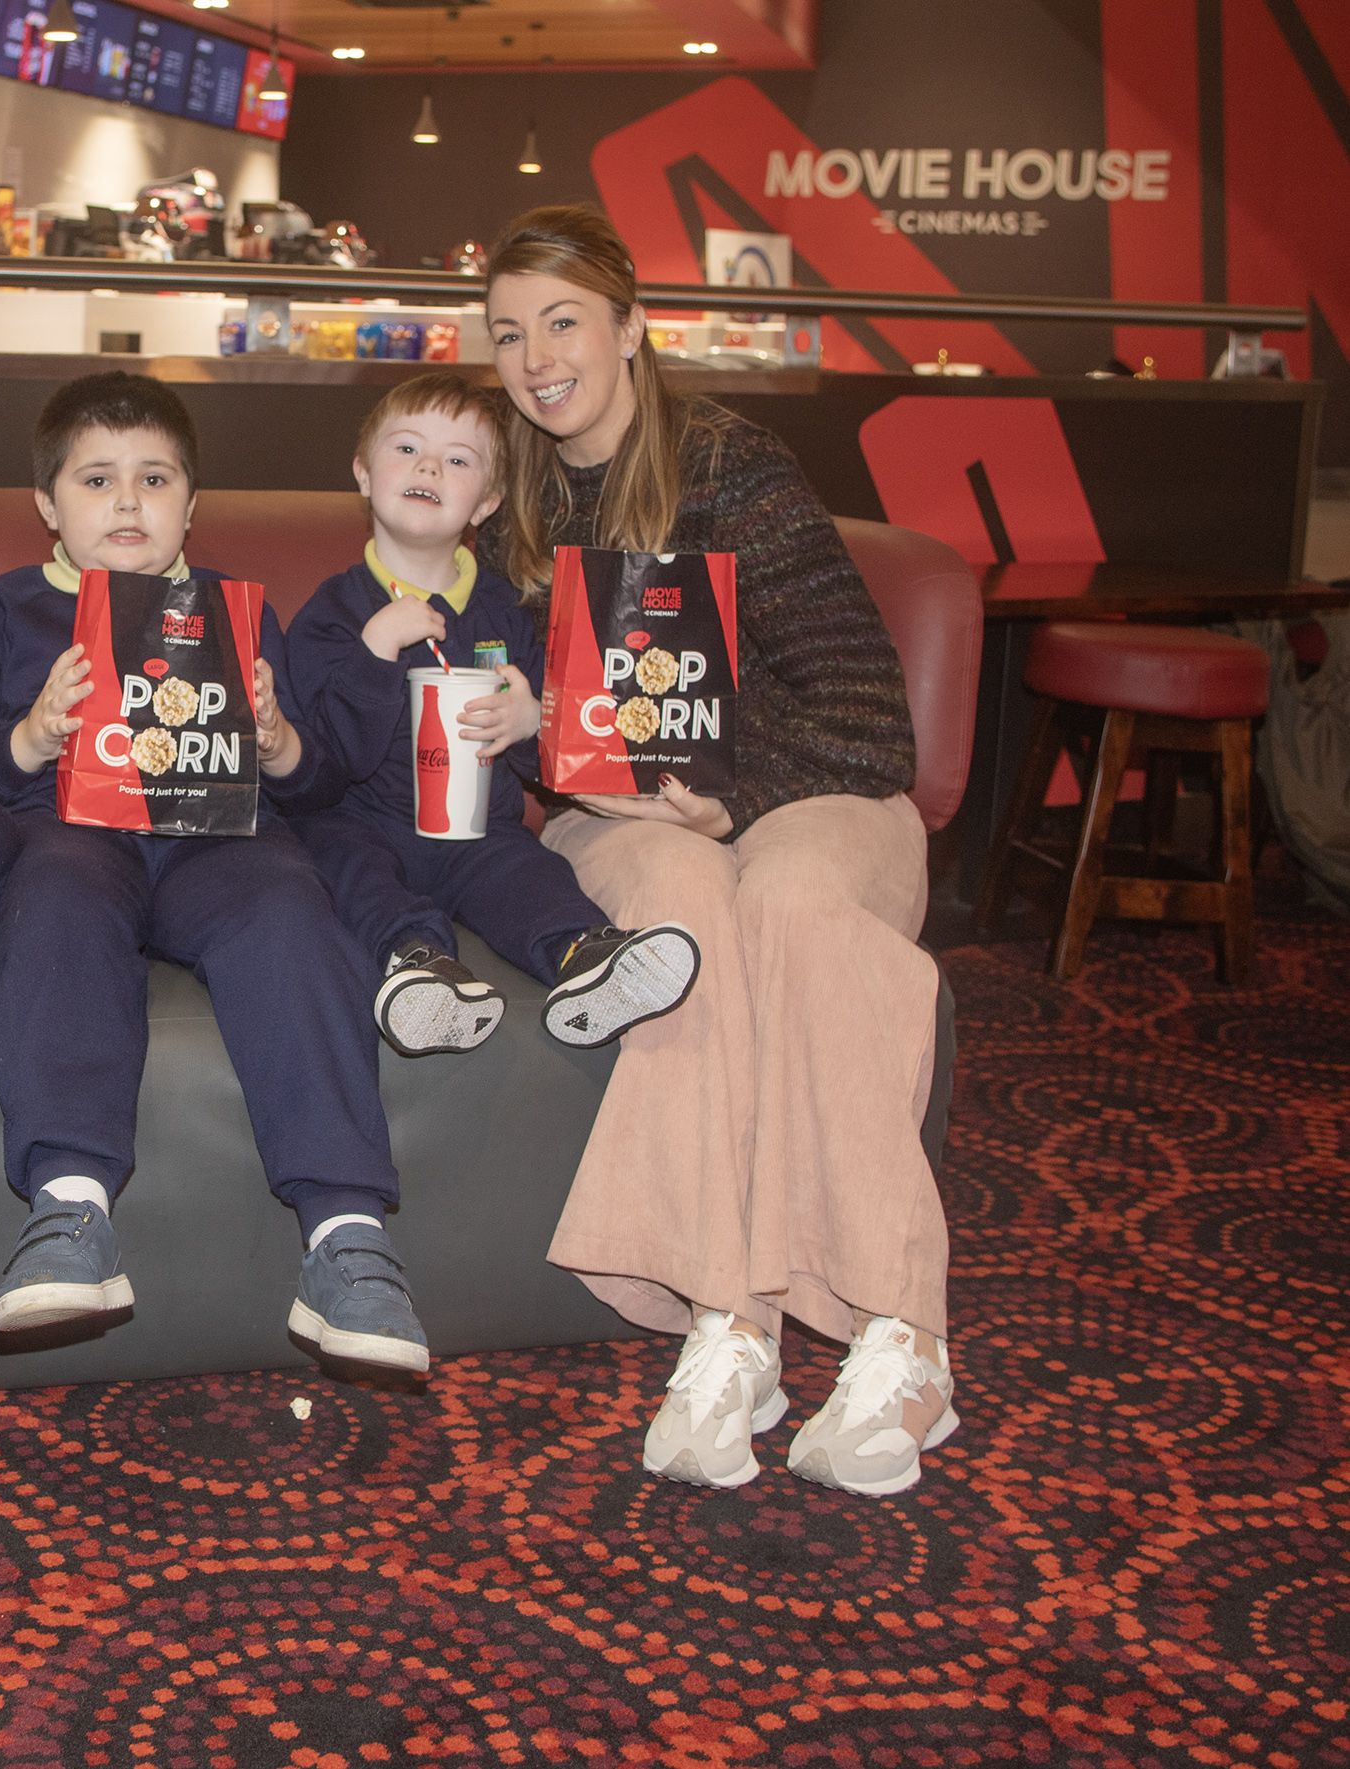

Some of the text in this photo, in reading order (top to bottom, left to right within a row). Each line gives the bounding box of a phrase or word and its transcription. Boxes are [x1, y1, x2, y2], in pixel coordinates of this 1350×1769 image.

[764, 149, 1171, 200] MOVIE HOUSE
[898, 210, 1020, 234] CINEMAS
[644, 587, 682, 598] MOVIE
[642, 597, 682, 608] HOUSE
[161, 623, 205, 638] HOUSE
[605, 752, 692, 764] Popped just for you!
[119, 784, 208, 797] Popped just for you!
